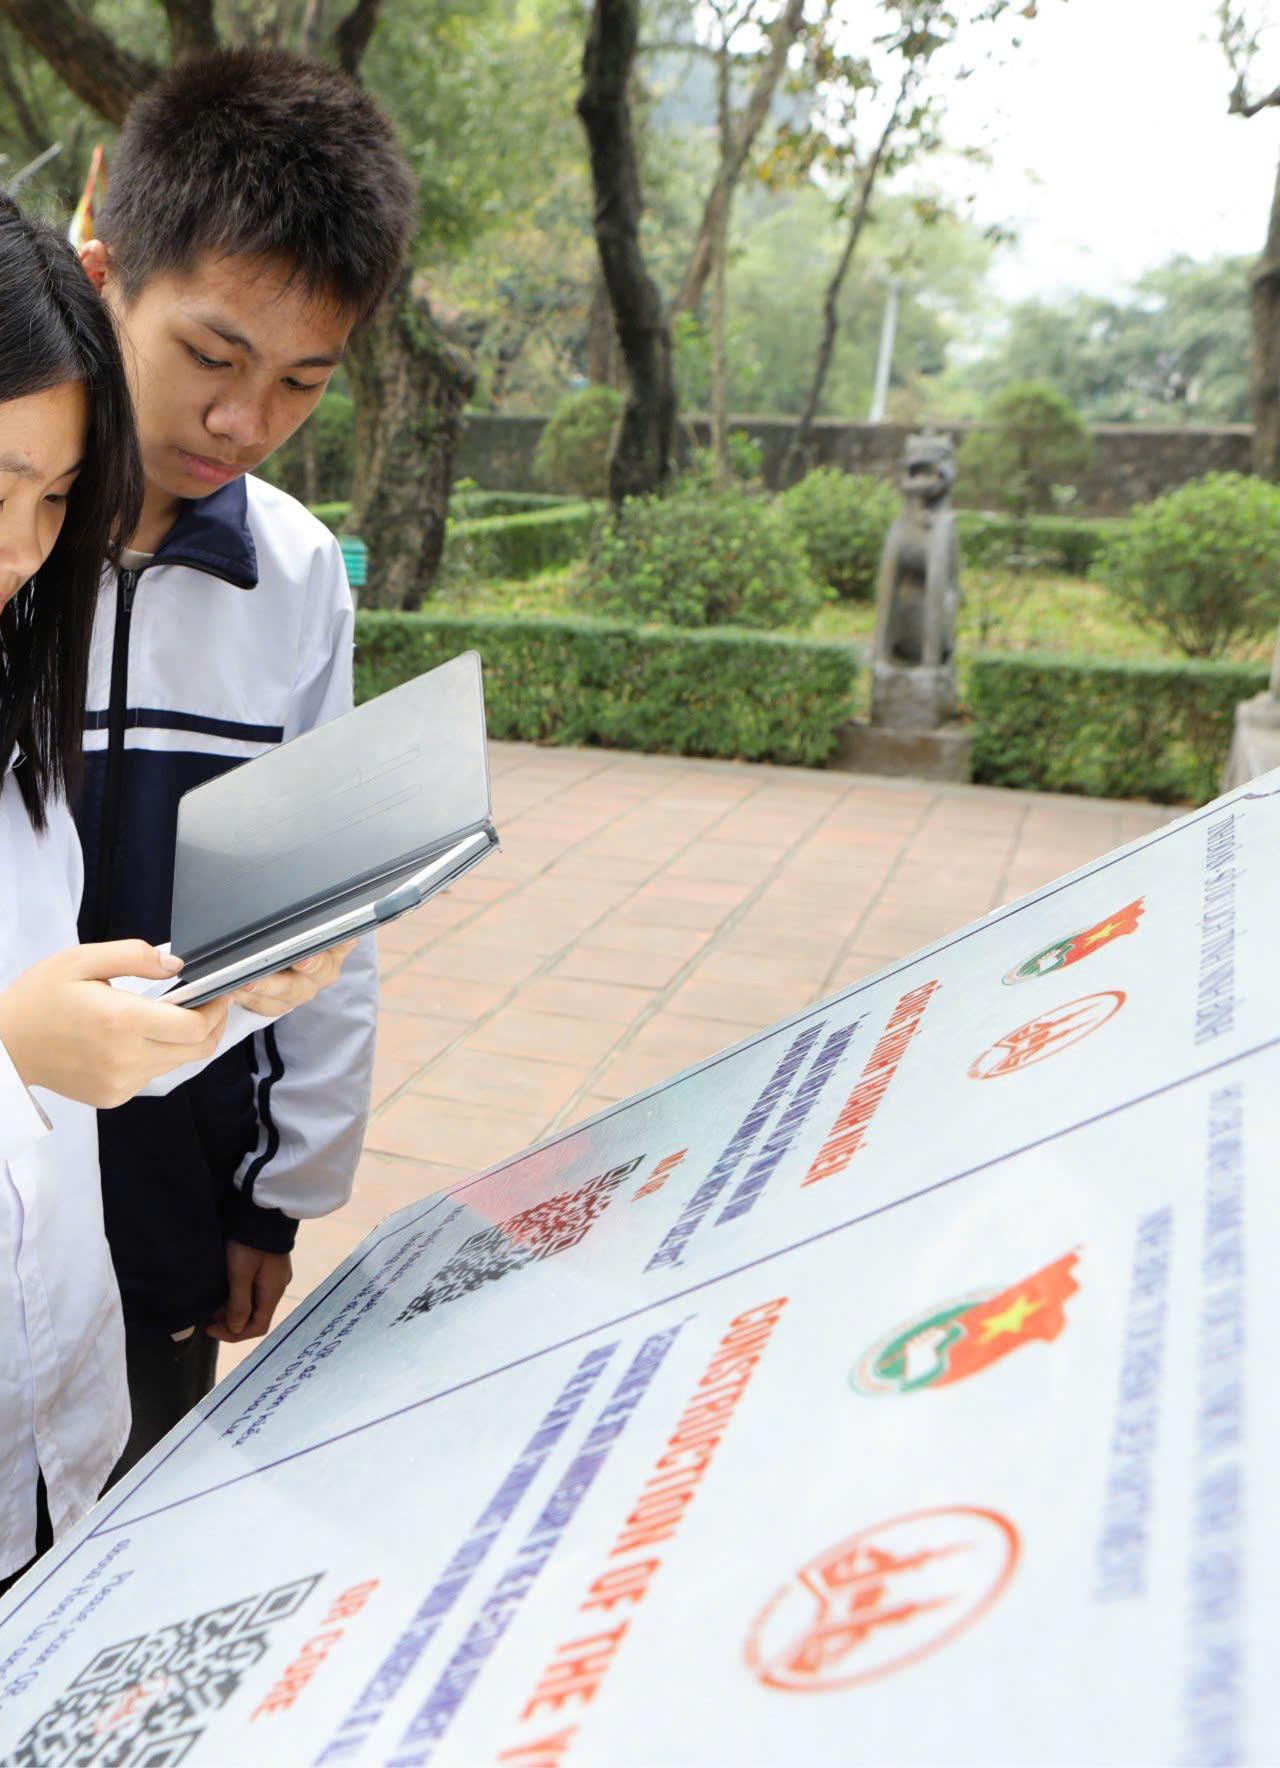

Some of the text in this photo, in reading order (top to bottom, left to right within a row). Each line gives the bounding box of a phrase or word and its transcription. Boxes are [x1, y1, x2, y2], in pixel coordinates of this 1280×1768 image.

[244, 1382, 282, 1415] Hoa
[609, 1296, 789, 1558] CONSTRUCTION
[578, 1558, 664, 1613] OF
[520, 1618, 632, 1723] THE
[497, 1723, 580, 1768] Y
